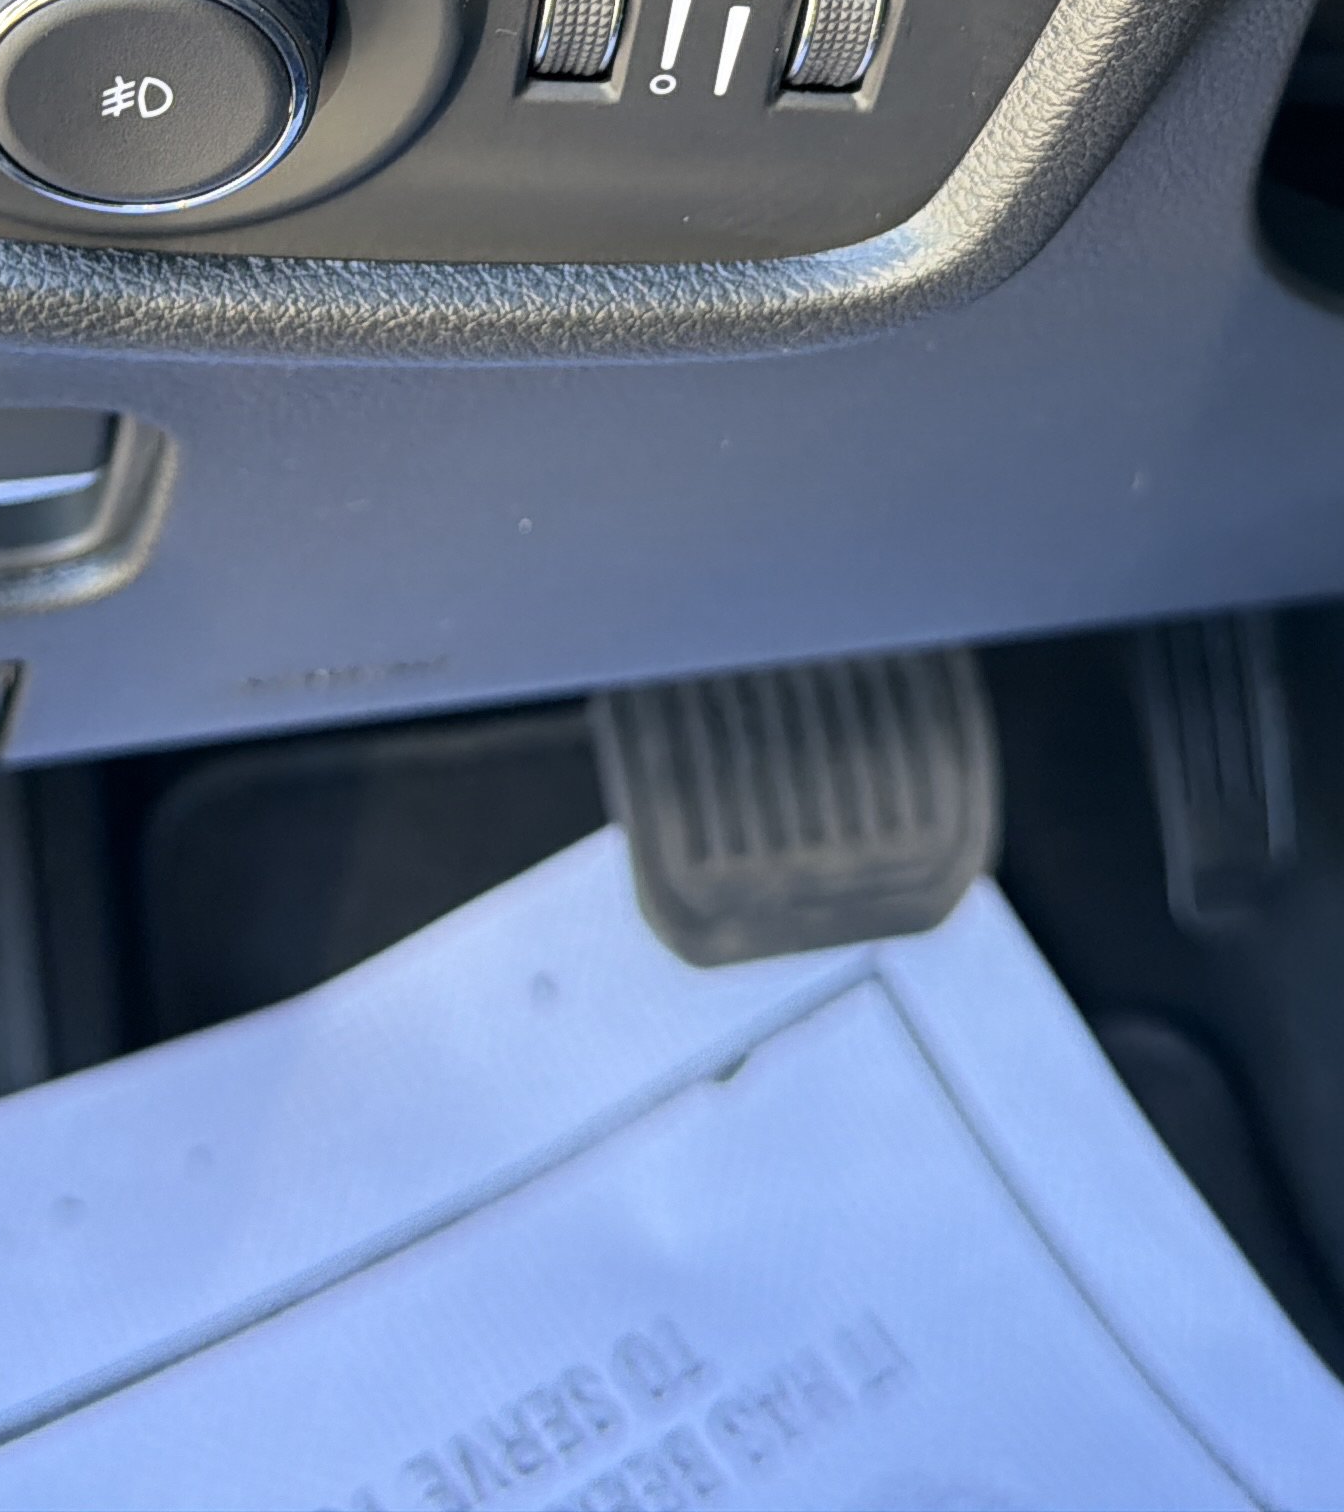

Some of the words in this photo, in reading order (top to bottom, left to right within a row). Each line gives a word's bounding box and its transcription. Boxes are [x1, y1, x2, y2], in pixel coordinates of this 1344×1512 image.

[614, 1315, 712, 1404] TO
[710, 1346, 848, 1472] HAS
[401, 1362, 628, 1512] SERVE
